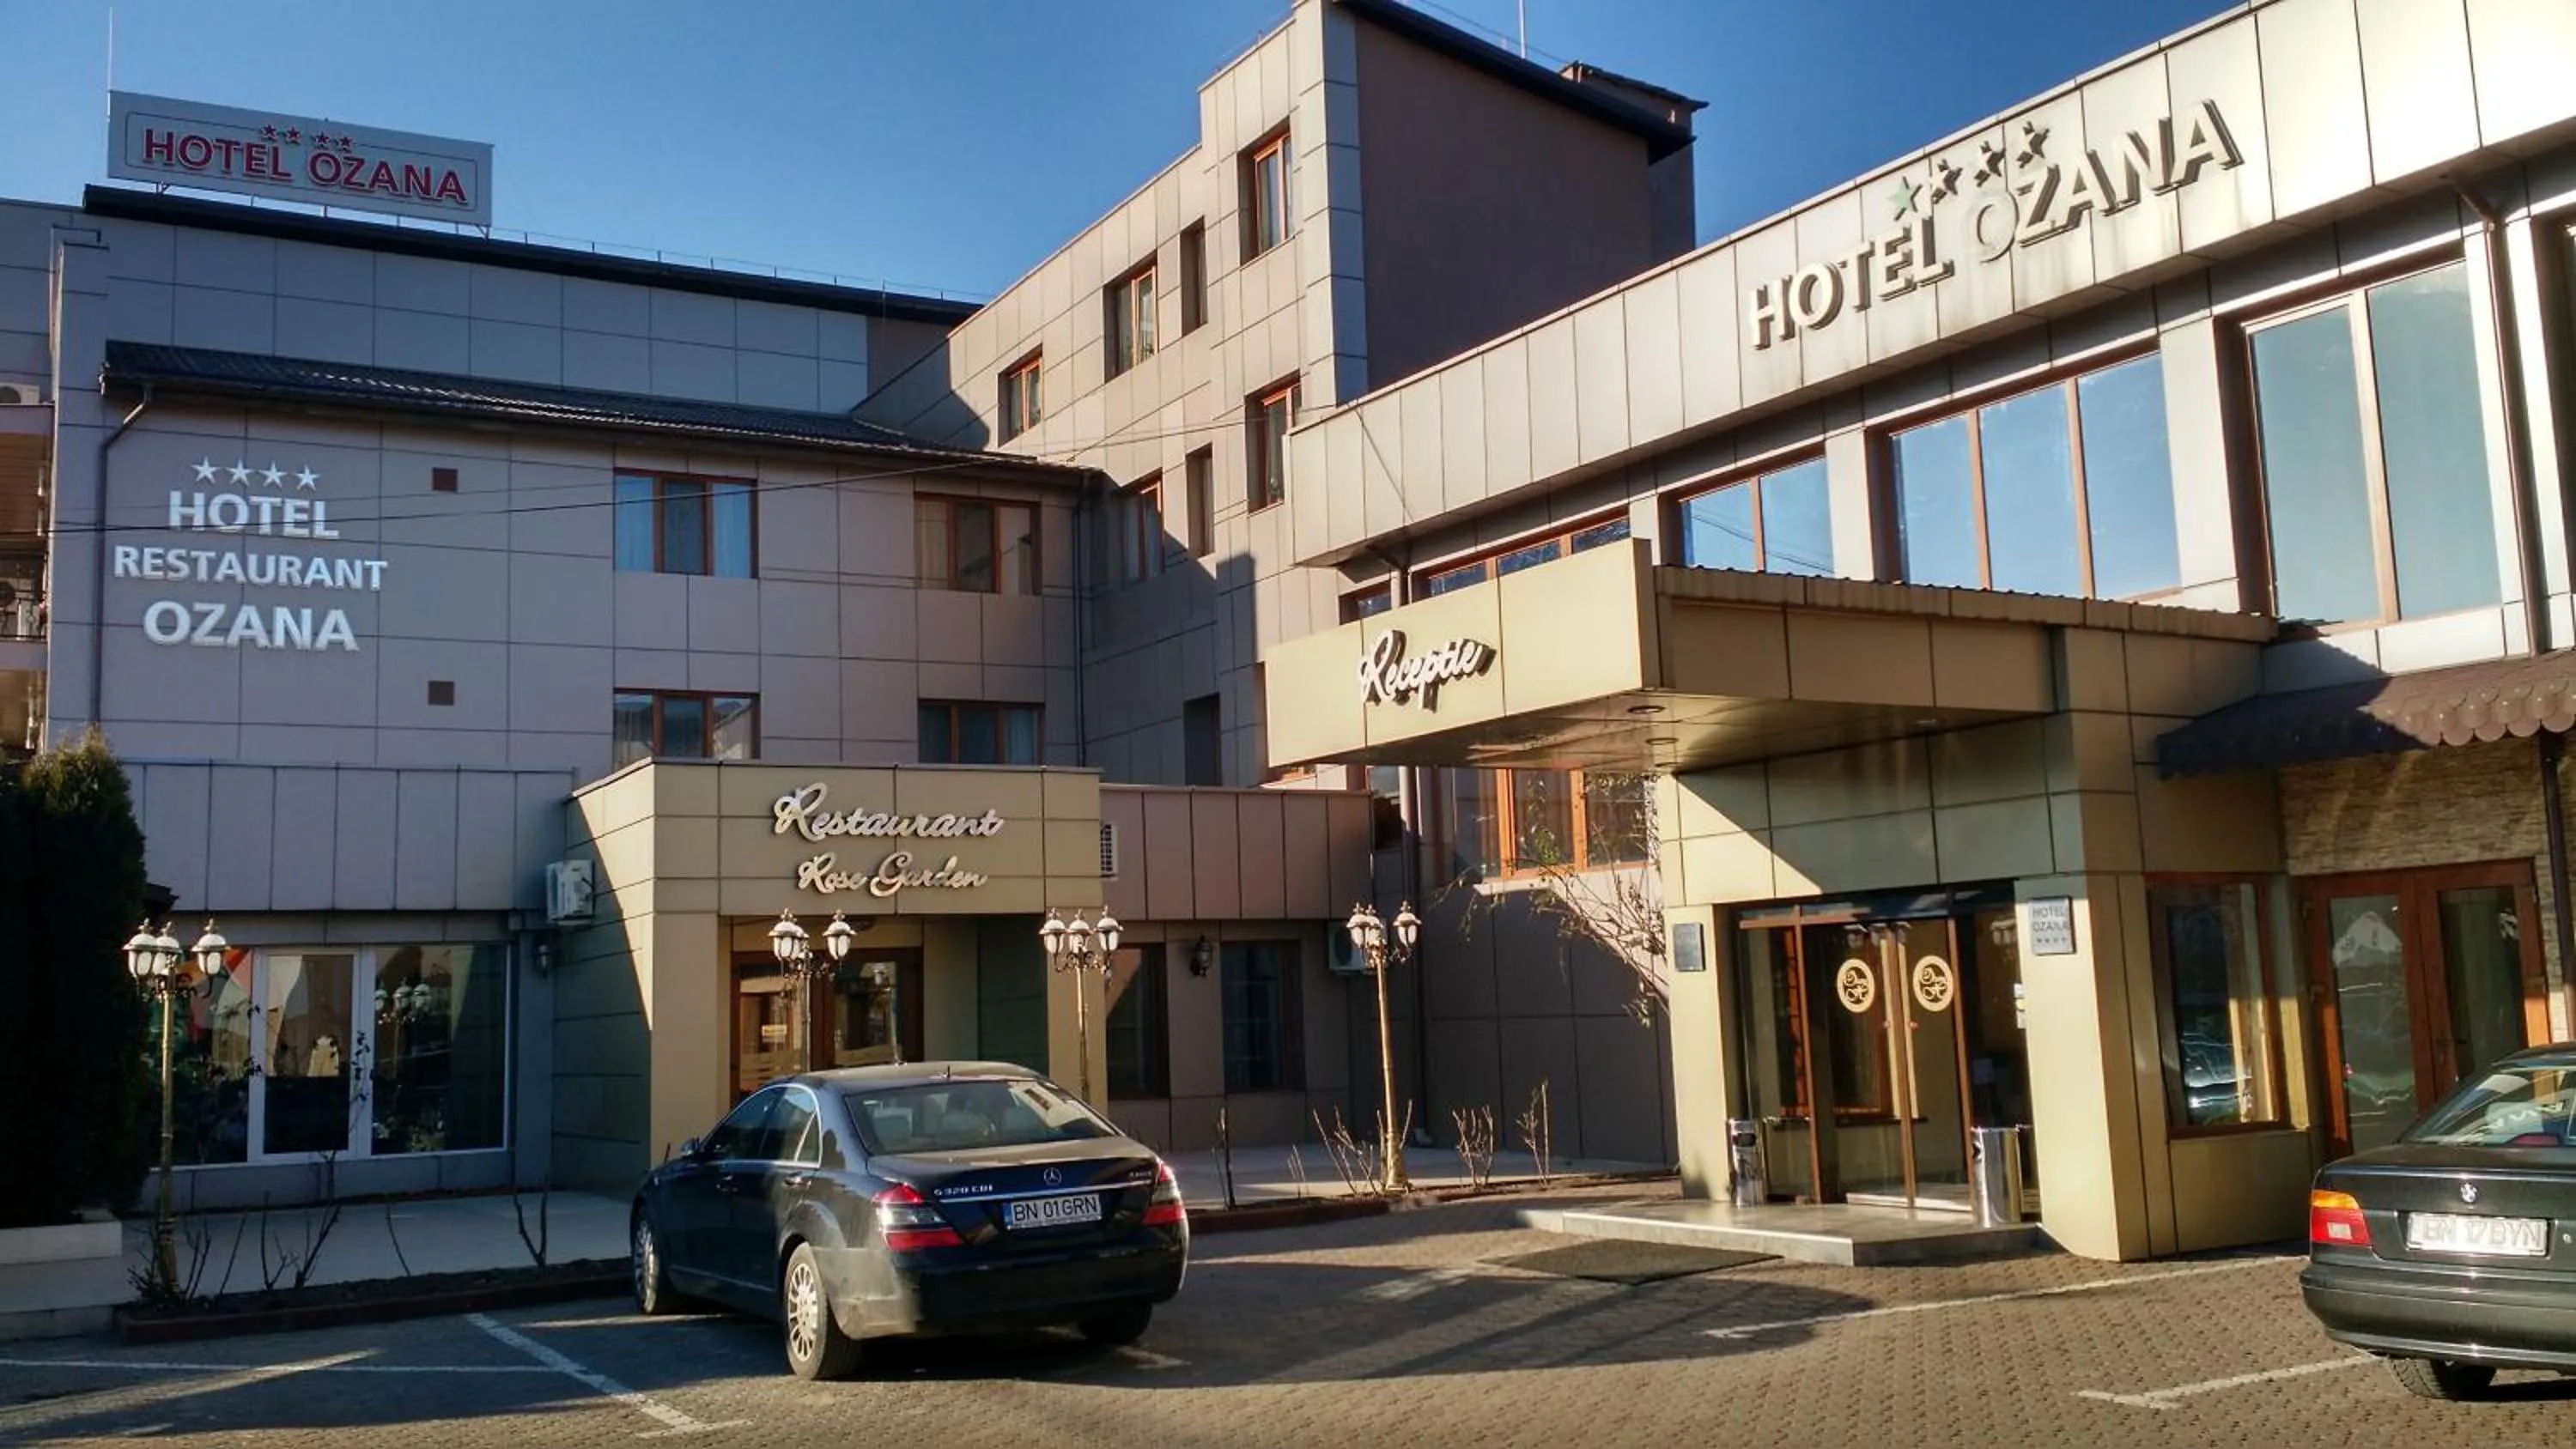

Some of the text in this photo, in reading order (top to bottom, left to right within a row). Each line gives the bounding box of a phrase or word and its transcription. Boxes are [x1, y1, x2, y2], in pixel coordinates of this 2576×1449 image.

[143, 127, 470, 205] HOTEL OZANA
[1749, 98, 2245, 352] HOTEL OZANA
[168, 489, 340, 540] HOTEL
[113, 544, 389, 591] RESTAURANT
[143, 600, 361, 652] OZANA
[772, 782, 1005, 842] Restaurant
[797, 850, 989, 898] Rose Garden
[1013, 1203, 1038, 1221] BN
